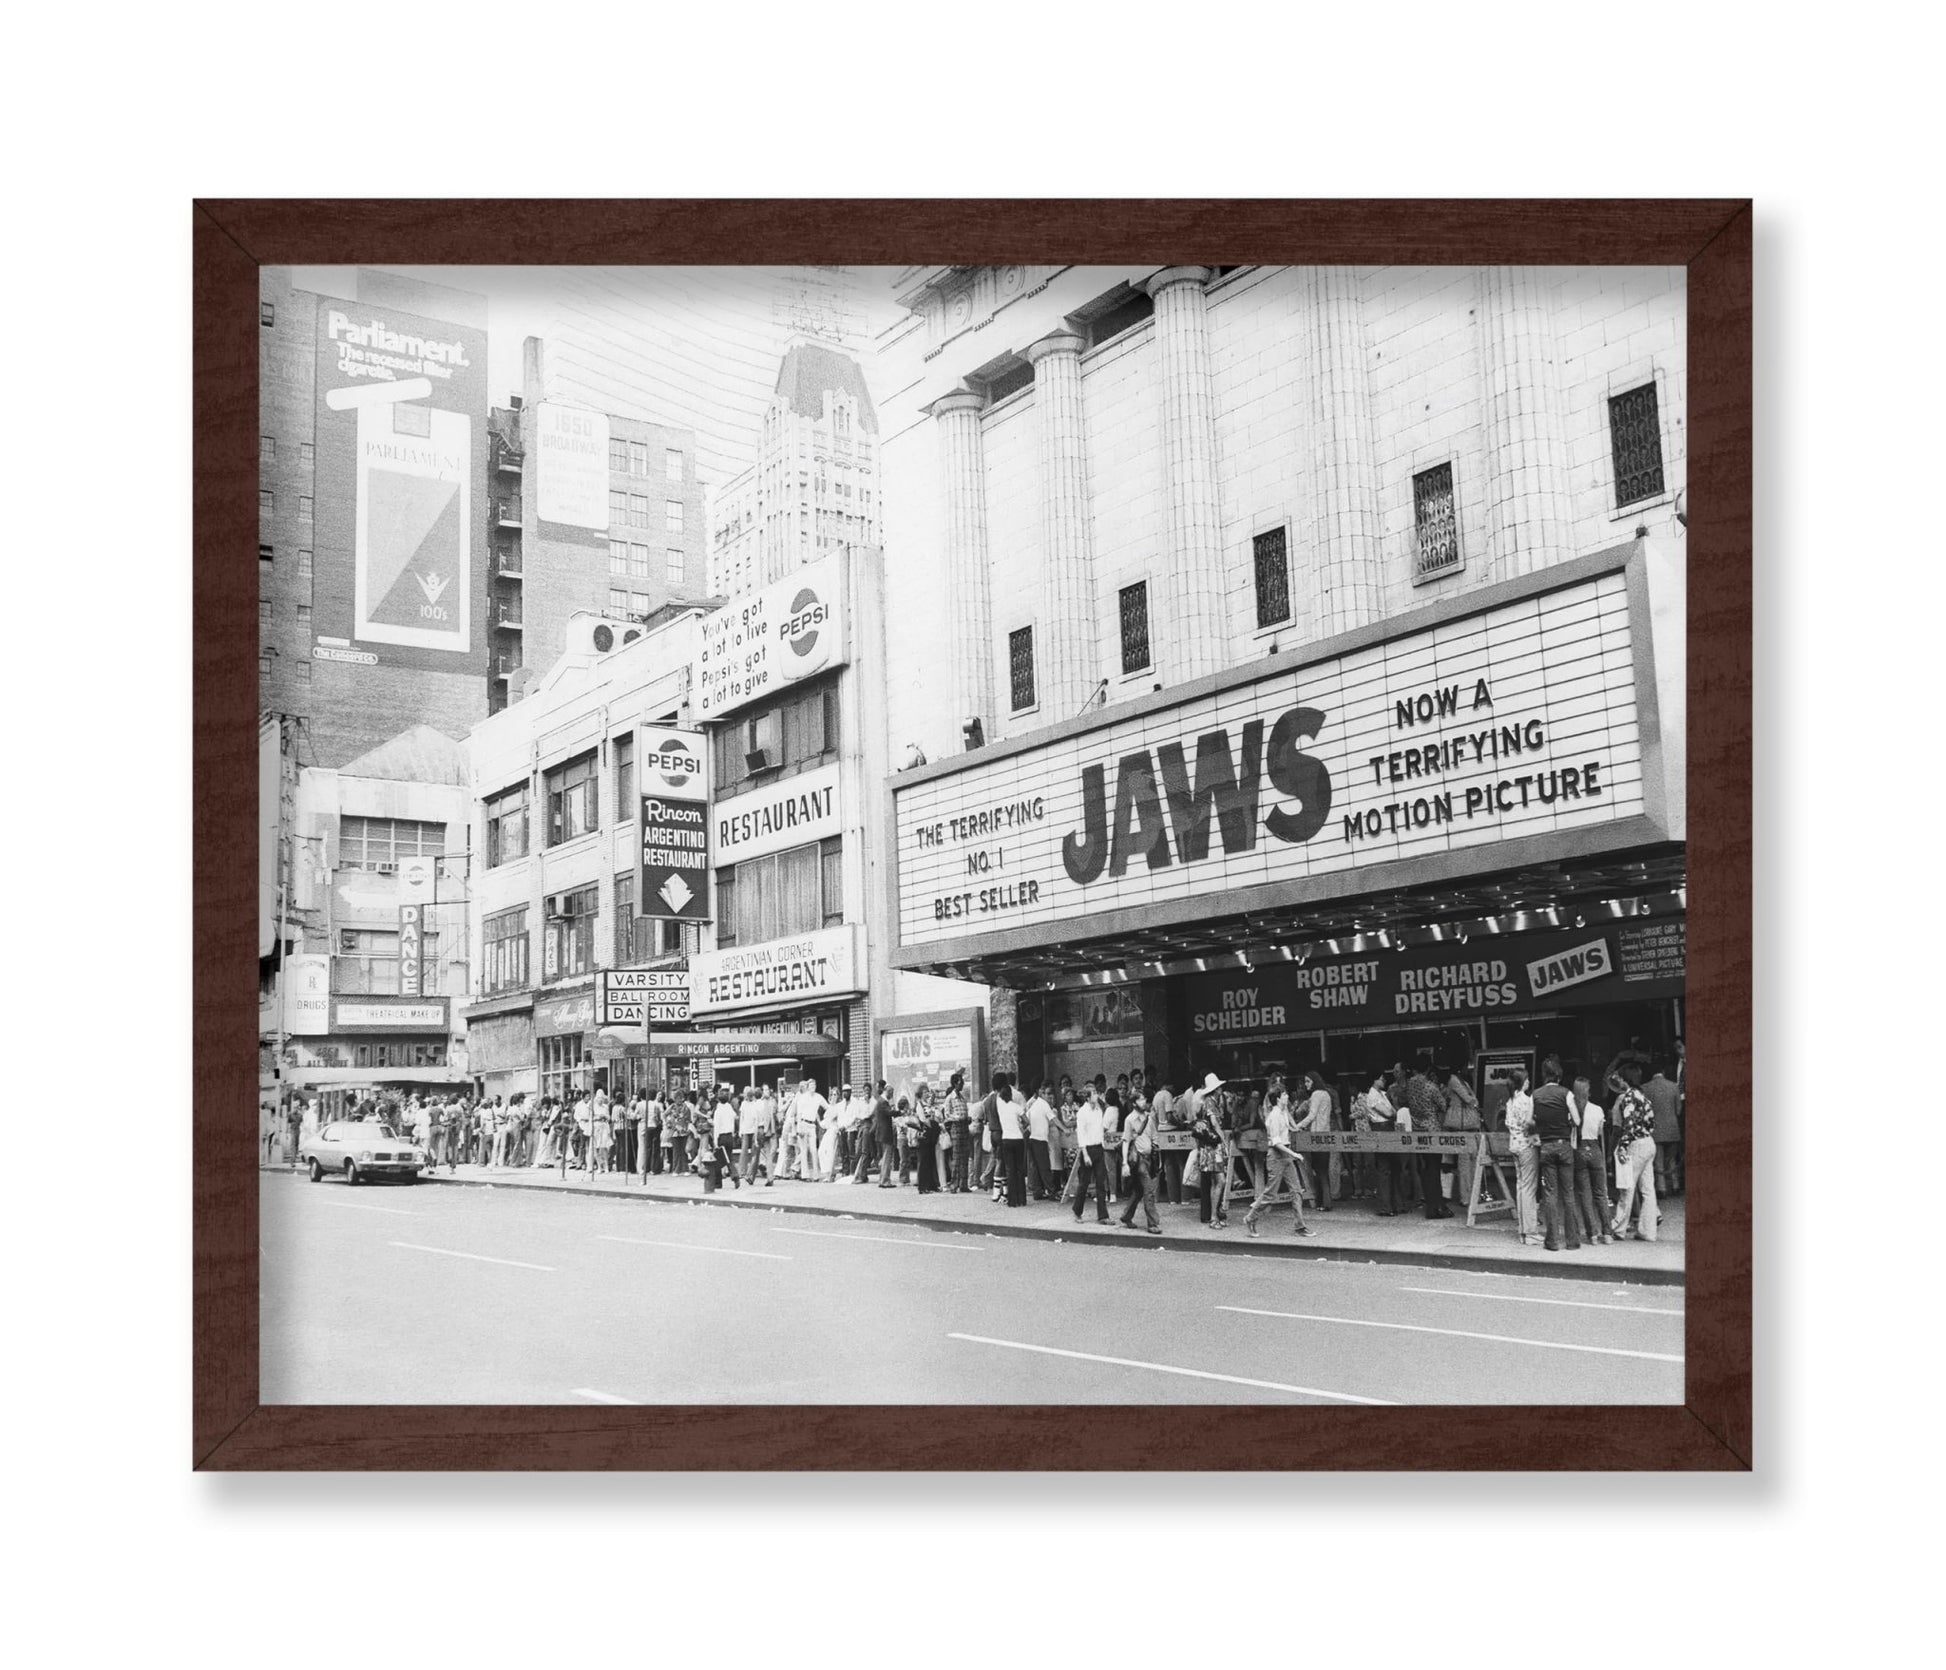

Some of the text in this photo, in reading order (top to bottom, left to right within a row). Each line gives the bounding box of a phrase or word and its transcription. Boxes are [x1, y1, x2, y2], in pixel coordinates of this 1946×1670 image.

[328, 309, 470, 367] Parliament.
[336, 341, 364, 361] The
[364, 351, 423, 373] recessed
[420, 604, 448, 621] 100's
[702, 597, 763, 641] You've got
[780, 603, 829, 640] PEPSI
[701, 621, 767, 662] a lot to live
[745, 644, 766, 672] got
[702, 671, 768, 709] a lot to give
[1396, 677, 1494, 730] NOW A
[648, 752, 701, 774] PEPSI
[1369, 719, 1544, 786] TERRIFYING
[1062, 706, 1332, 885] JAWS
[1343, 762, 1602, 844] MOTION PICTURE
[645, 799, 703, 823] Rincon
[720, 786, 833, 848] RESTAURANT
[916, 797, 1043, 849] THE TERRIFYING
[644, 826, 705, 849] ARGENTINO
[643, 848, 707, 869] RESTAURANT
[935, 880, 1040, 920] BEST SELLER
[402, 906, 418, 995] DANCE
[777, 941, 814, 963] CORNER
[614, 974, 686, 985] VARSITY
[709, 957, 827, 1003] RESTAURANT
[1296, 961, 1379, 989] ROBERT
[1400, 960, 1507, 991] RICHARD
[1531, 947, 1604, 989] JAWS
[296, 1000, 327, 1010] DRUGS
[1222, 987, 1259, 1009] ROY
[1310, 985, 1369, 1009] SHAW
[1394, 982, 1518, 1015] DREYFUSS
[613, 1006, 687, 1019] DANCING
[762, 1019, 800, 1034] ARGENTINO
[1193, 1006, 1286, 1033] SCHEIDER
[678, 1043, 760, 1055] RINCON ARGENTINO
[892, 1034, 931, 1059] JAWS
[1167, 1135, 1176, 1143] DO
[1310, 1134, 1466, 1147] POLICE LINE DO NOT CROSS
